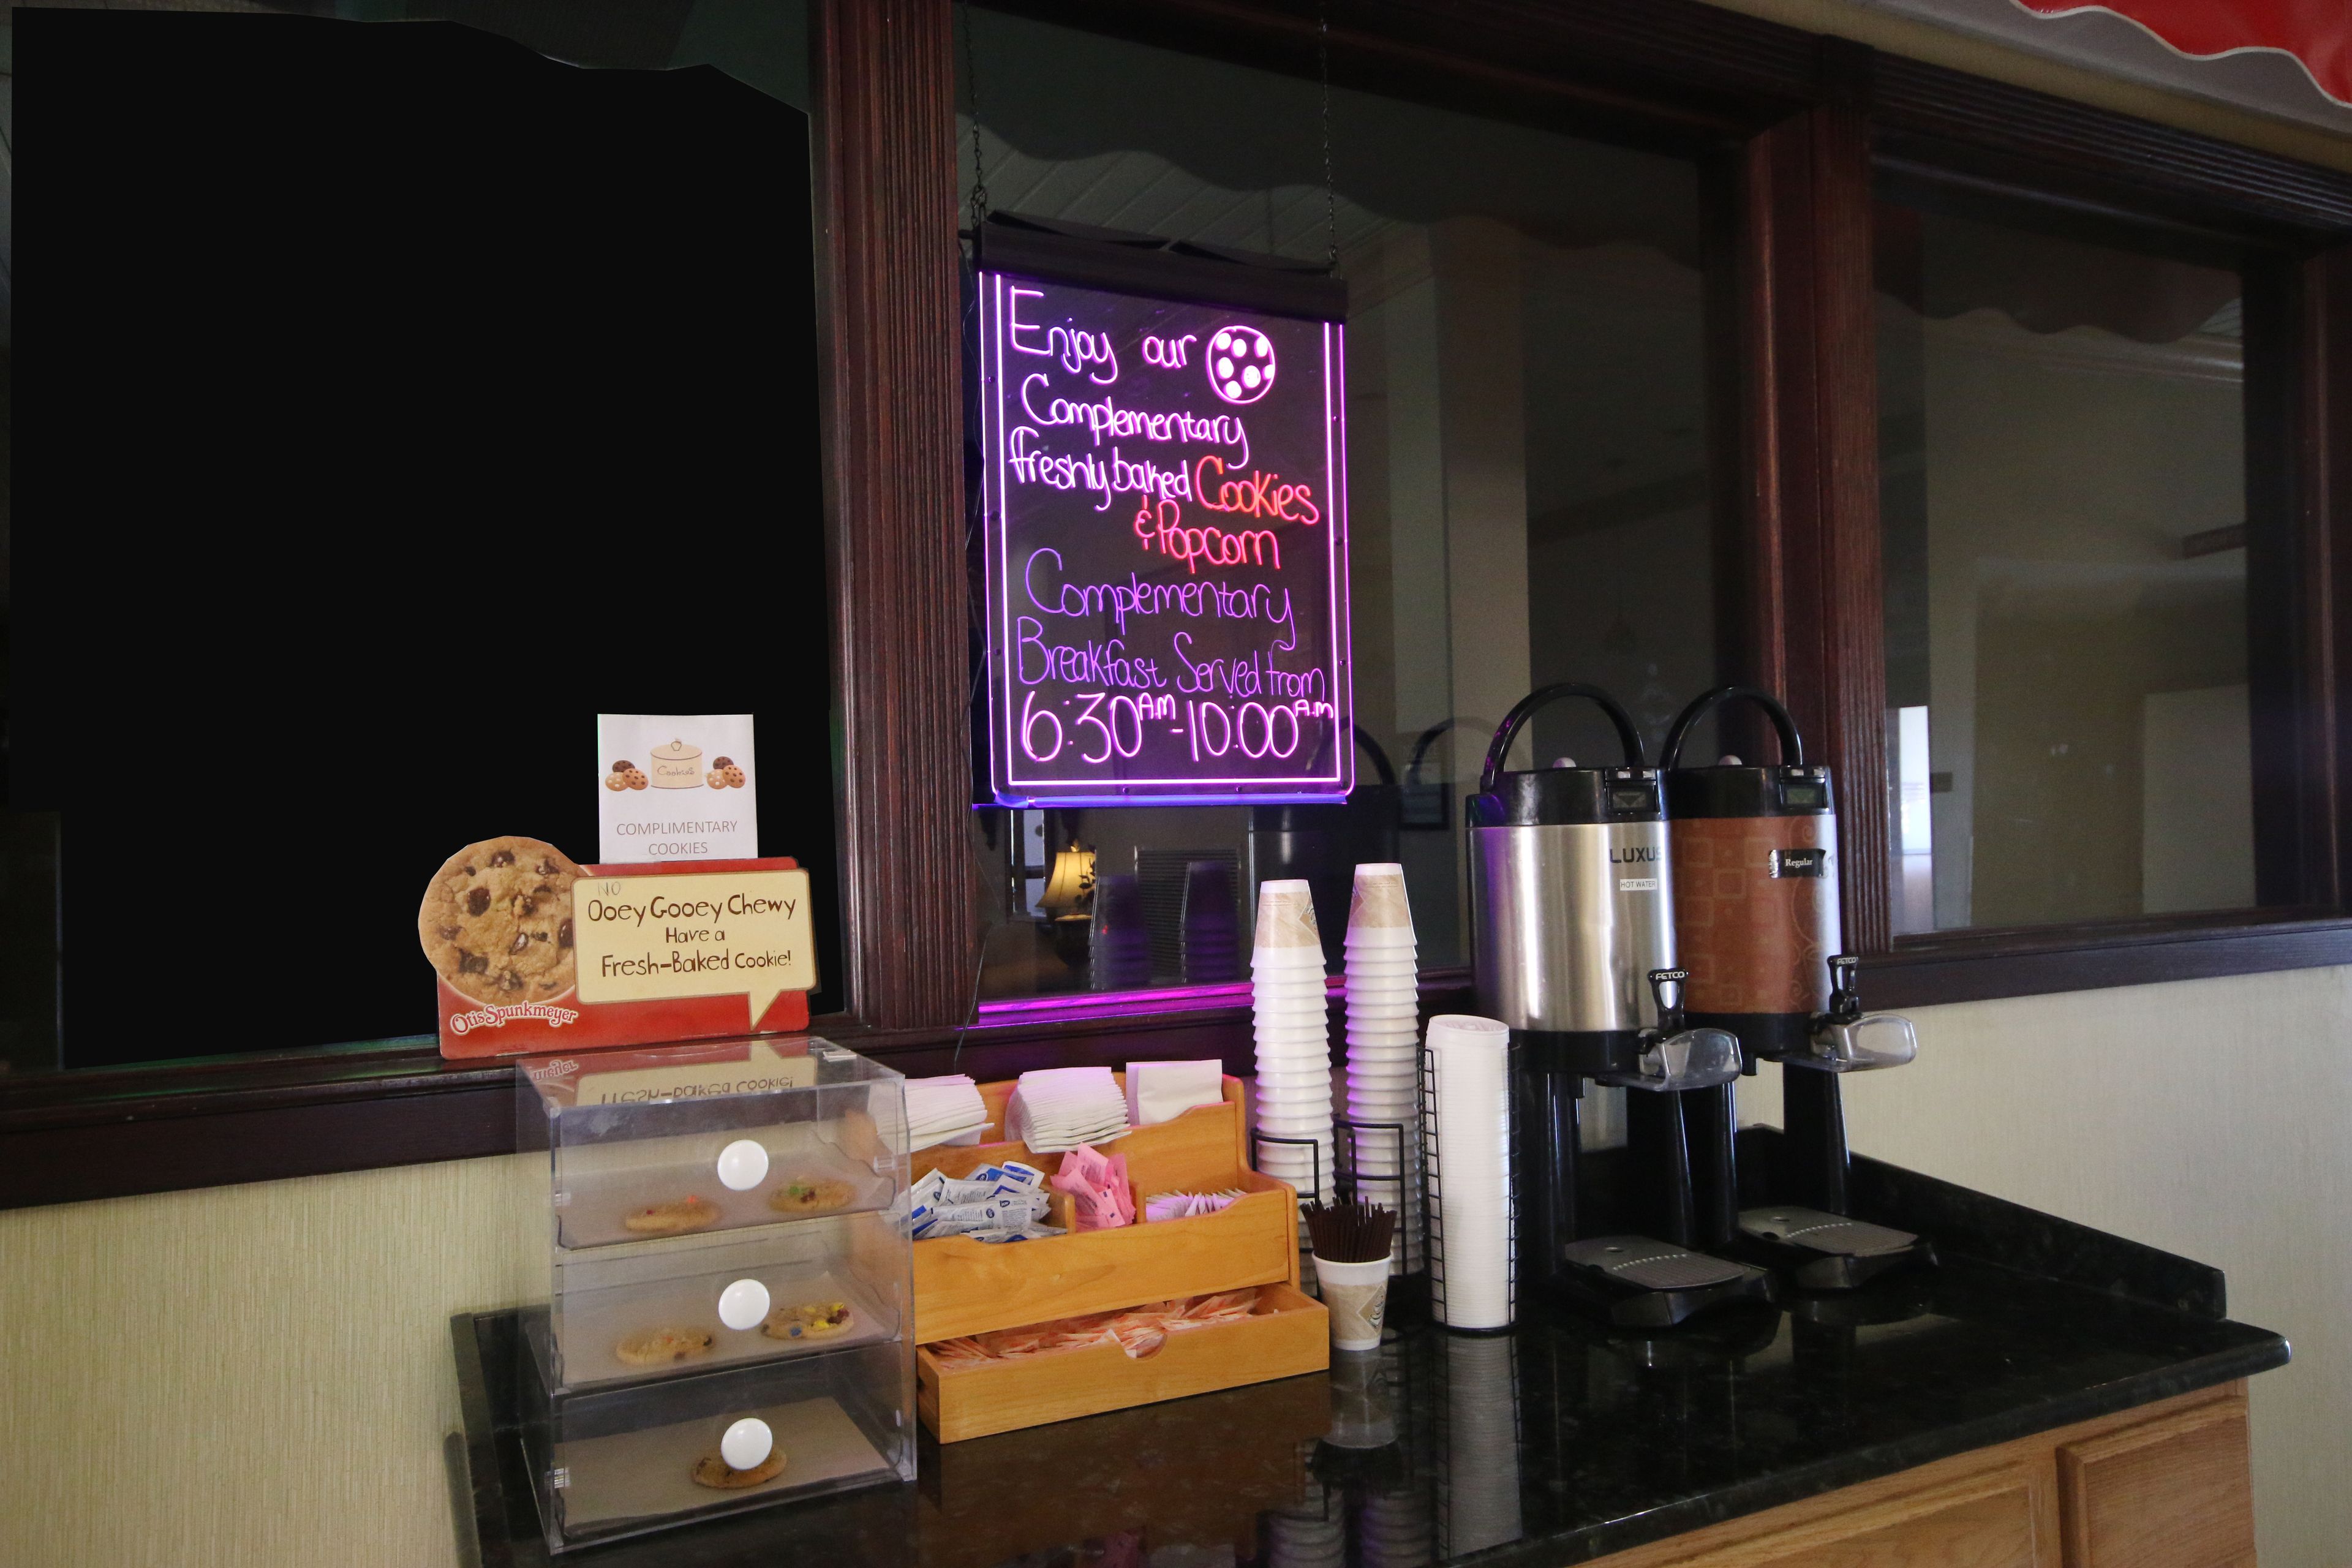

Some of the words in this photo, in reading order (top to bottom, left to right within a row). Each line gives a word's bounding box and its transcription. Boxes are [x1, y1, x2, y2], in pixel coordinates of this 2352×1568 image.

[1009, 285, 1118, 385] Enjoy
[1142, 334, 1197, 368] our
[1022, 373, 1250, 469] Complementary
[1009, 426, 1111, 511] freshly
[1156, 499, 1280, 574] Popcorn
[1025, 548, 1295, 650] Complementary
[1017, 616, 1167, 688] Breakfast
[1174, 631, 1262, 697] Served
[1265, 639, 1325, 702] from
[657, 765, 695, 776] Cookies
[616, 820, 737, 835] COMPLIMENTARY
[648, 842, 708, 855] COOKIES
[1785, 858, 1813, 868] Regular
[598, 881, 621, 896] NO
[588, 899, 646, 927] Ooey
[650, 896, 723, 923] Gooey
[728, 893, 796, 919] Chewy
[665, 927, 709, 943] Have
[715, 929, 725, 941] a
[601, 949, 729, 977] Fresh-Baked
[735, 950, 791, 968] Cookie!
[1656, 971, 1685, 980] FETCO
[451, 1011, 485, 1033] Otis
[484, 1001, 577, 1026] Spunkmeyer
